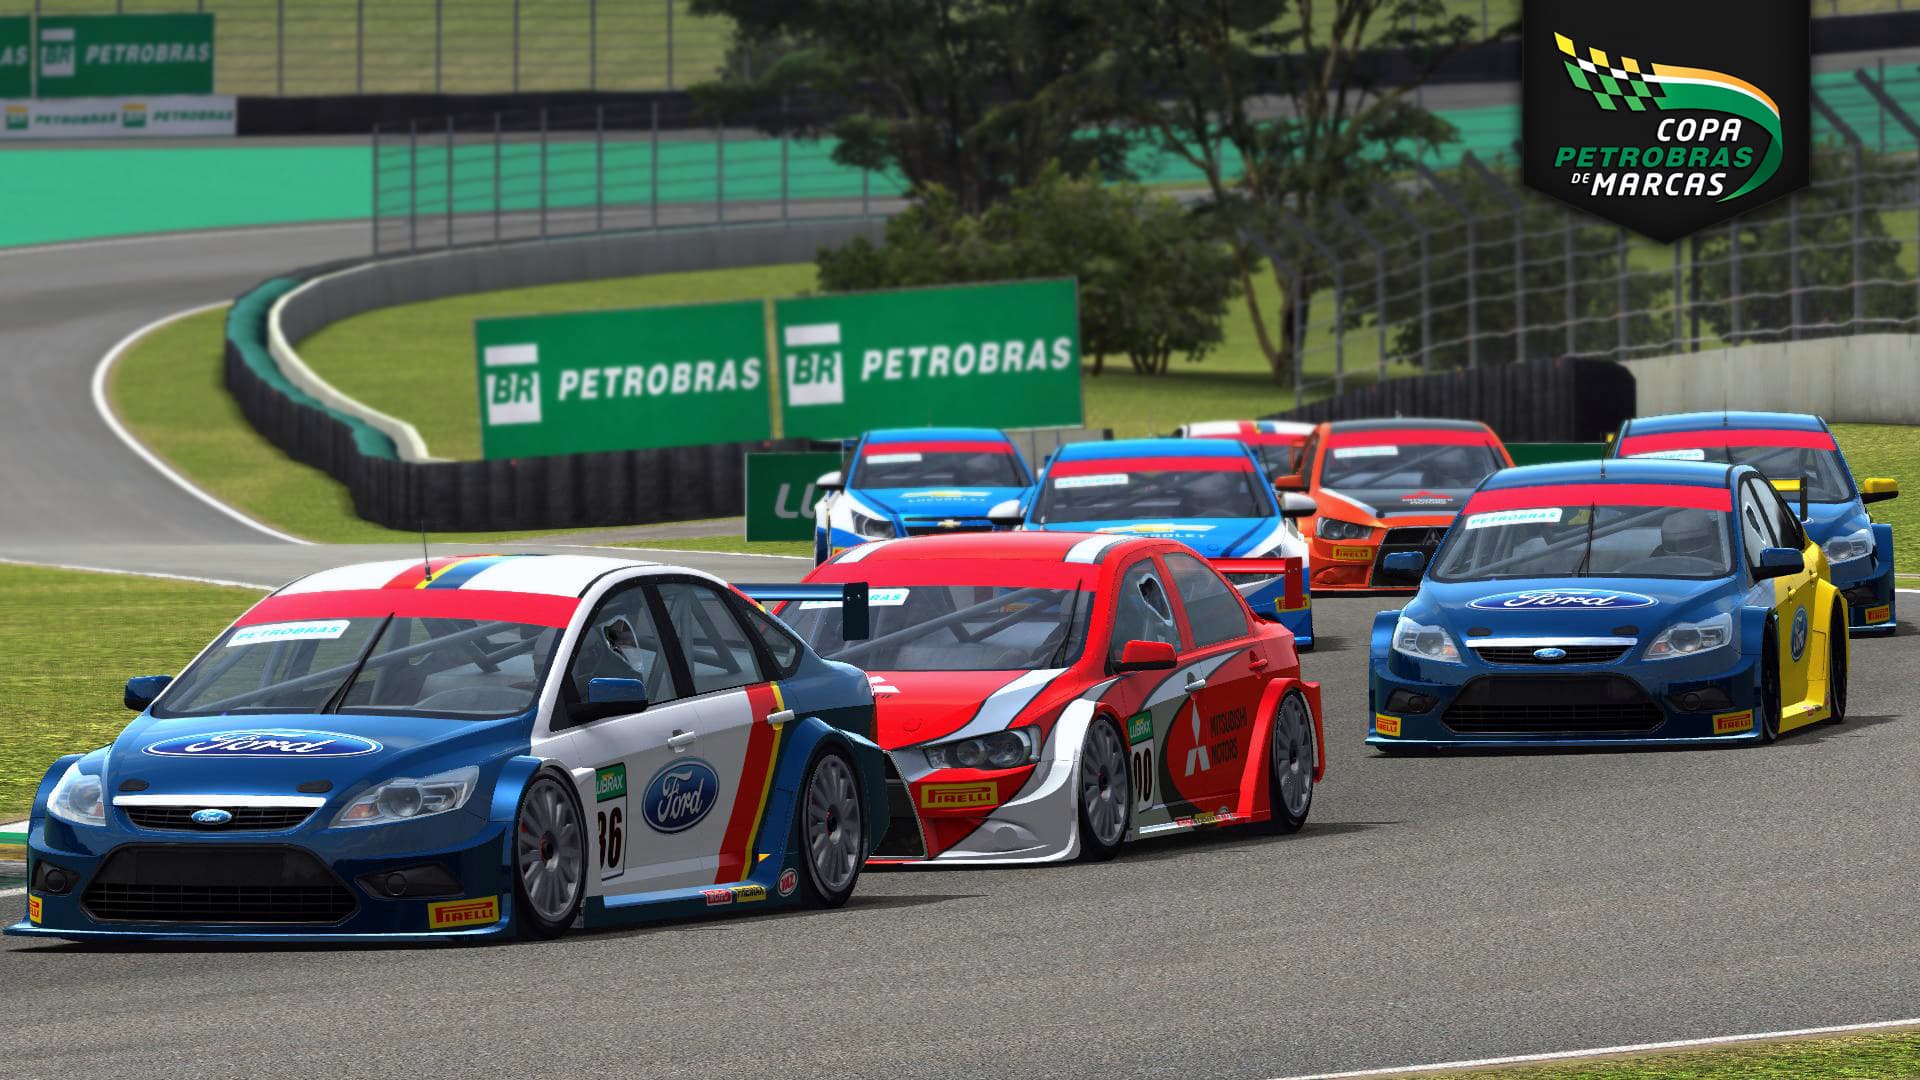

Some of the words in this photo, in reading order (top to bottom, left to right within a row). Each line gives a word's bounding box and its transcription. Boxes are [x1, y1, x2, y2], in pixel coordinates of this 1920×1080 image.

[85, 42, 210, 64] PETROBRAS
[791, 352, 837, 385] BR
[861, 337, 1072, 382] PETROBRAS
[490, 372, 538, 405] BR
[557, 357, 762, 402] PETROBRAS
[1503, 590, 1618, 607] Ford
[236, 625, 342, 642] PETROBRAS
[1210, 705, 1248, 738] MITSUBISHI
[1717, 713, 1751, 730] PIRELLI
[185, 731, 337, 754] Ford
[1212, 737, 1239, 768] MOTORS
[596, 774, 624, 795] UBRAX
[928, 786, 992, 804] PIRELLI
[658, 769, 705, 823] Ford
[435, 901, 494, 923] PIRELLI
